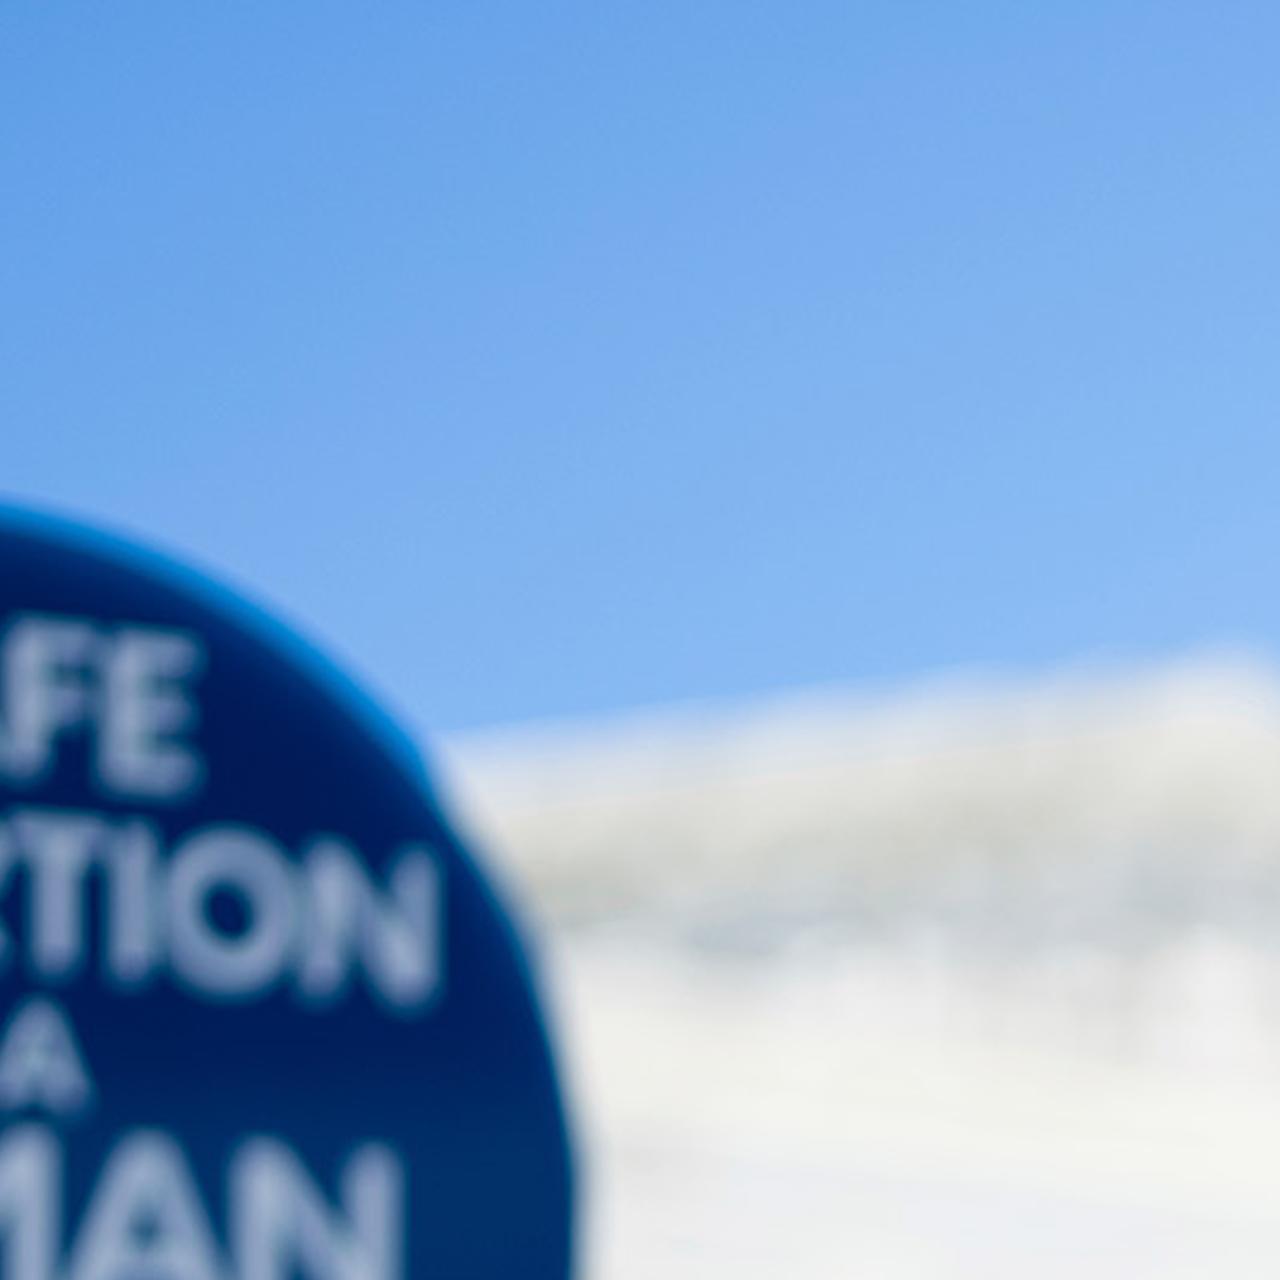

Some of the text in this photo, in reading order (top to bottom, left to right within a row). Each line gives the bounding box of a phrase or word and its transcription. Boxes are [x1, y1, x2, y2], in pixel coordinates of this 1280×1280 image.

[0, 610, 206, 796] FE
[0, 806, 446, 1012] TION
[0, 996, 94, 1120] A
